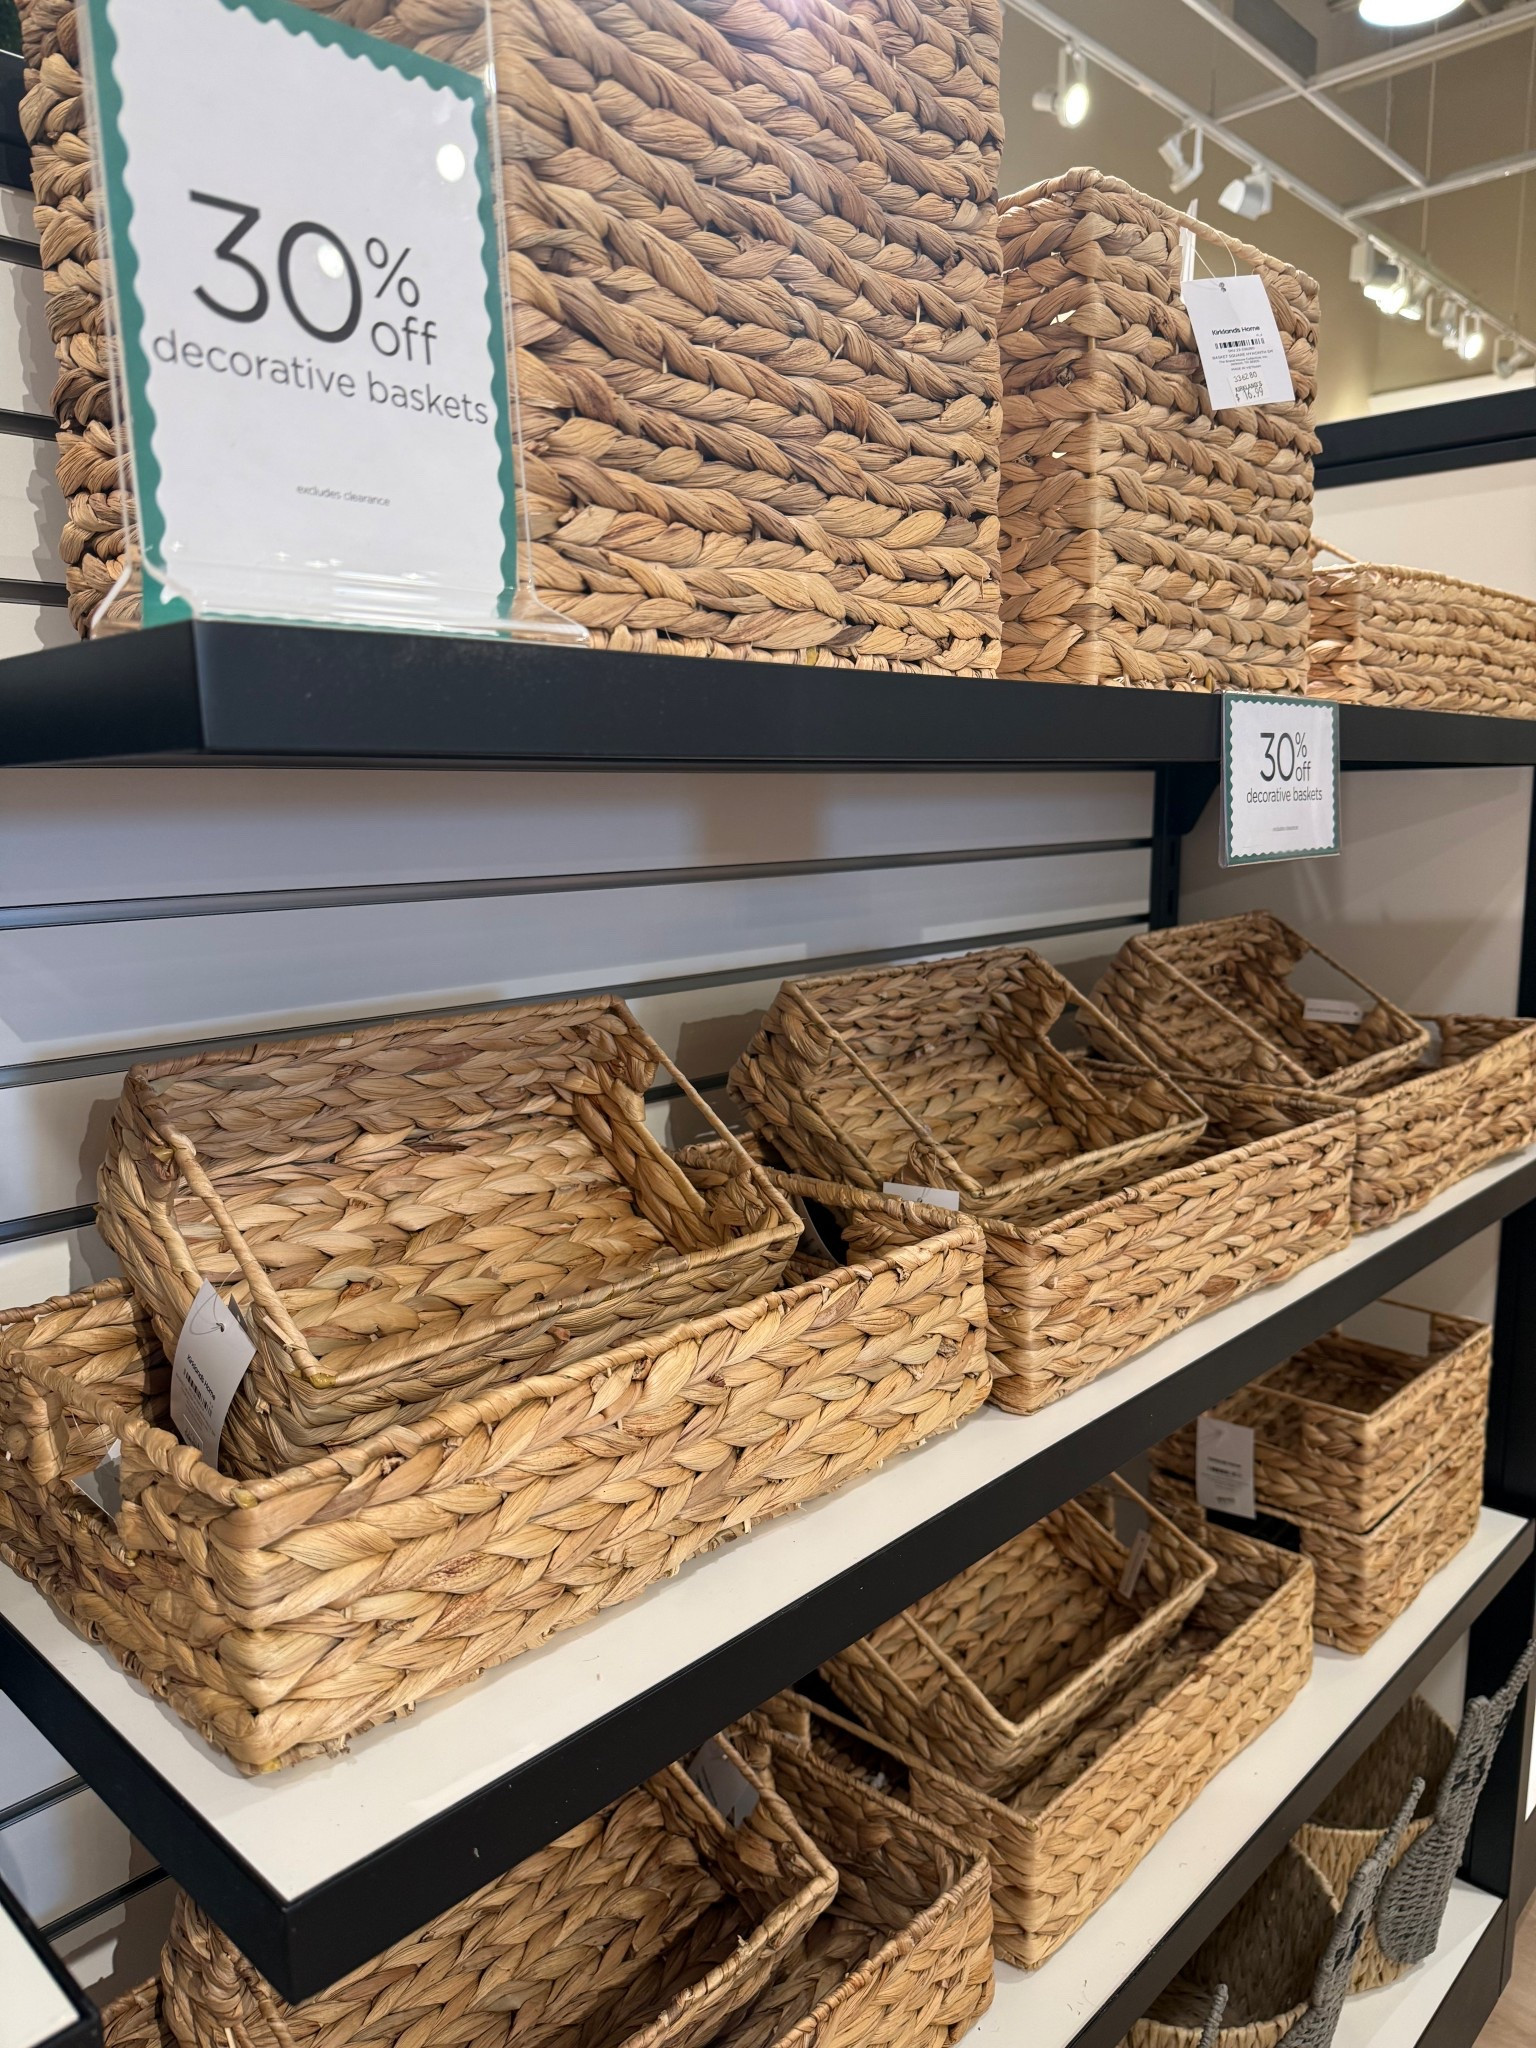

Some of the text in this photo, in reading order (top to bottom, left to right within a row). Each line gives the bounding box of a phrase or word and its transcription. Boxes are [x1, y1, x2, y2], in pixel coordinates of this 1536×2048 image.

[371, 316, 438, 366] off
[152, 329, 489, 425] decorative baskets
[296, 485, 391, 507] excludes clearance
[1295, 760, 1311, 782] off
[1246, 785, 1323, 804] decorative baskets
